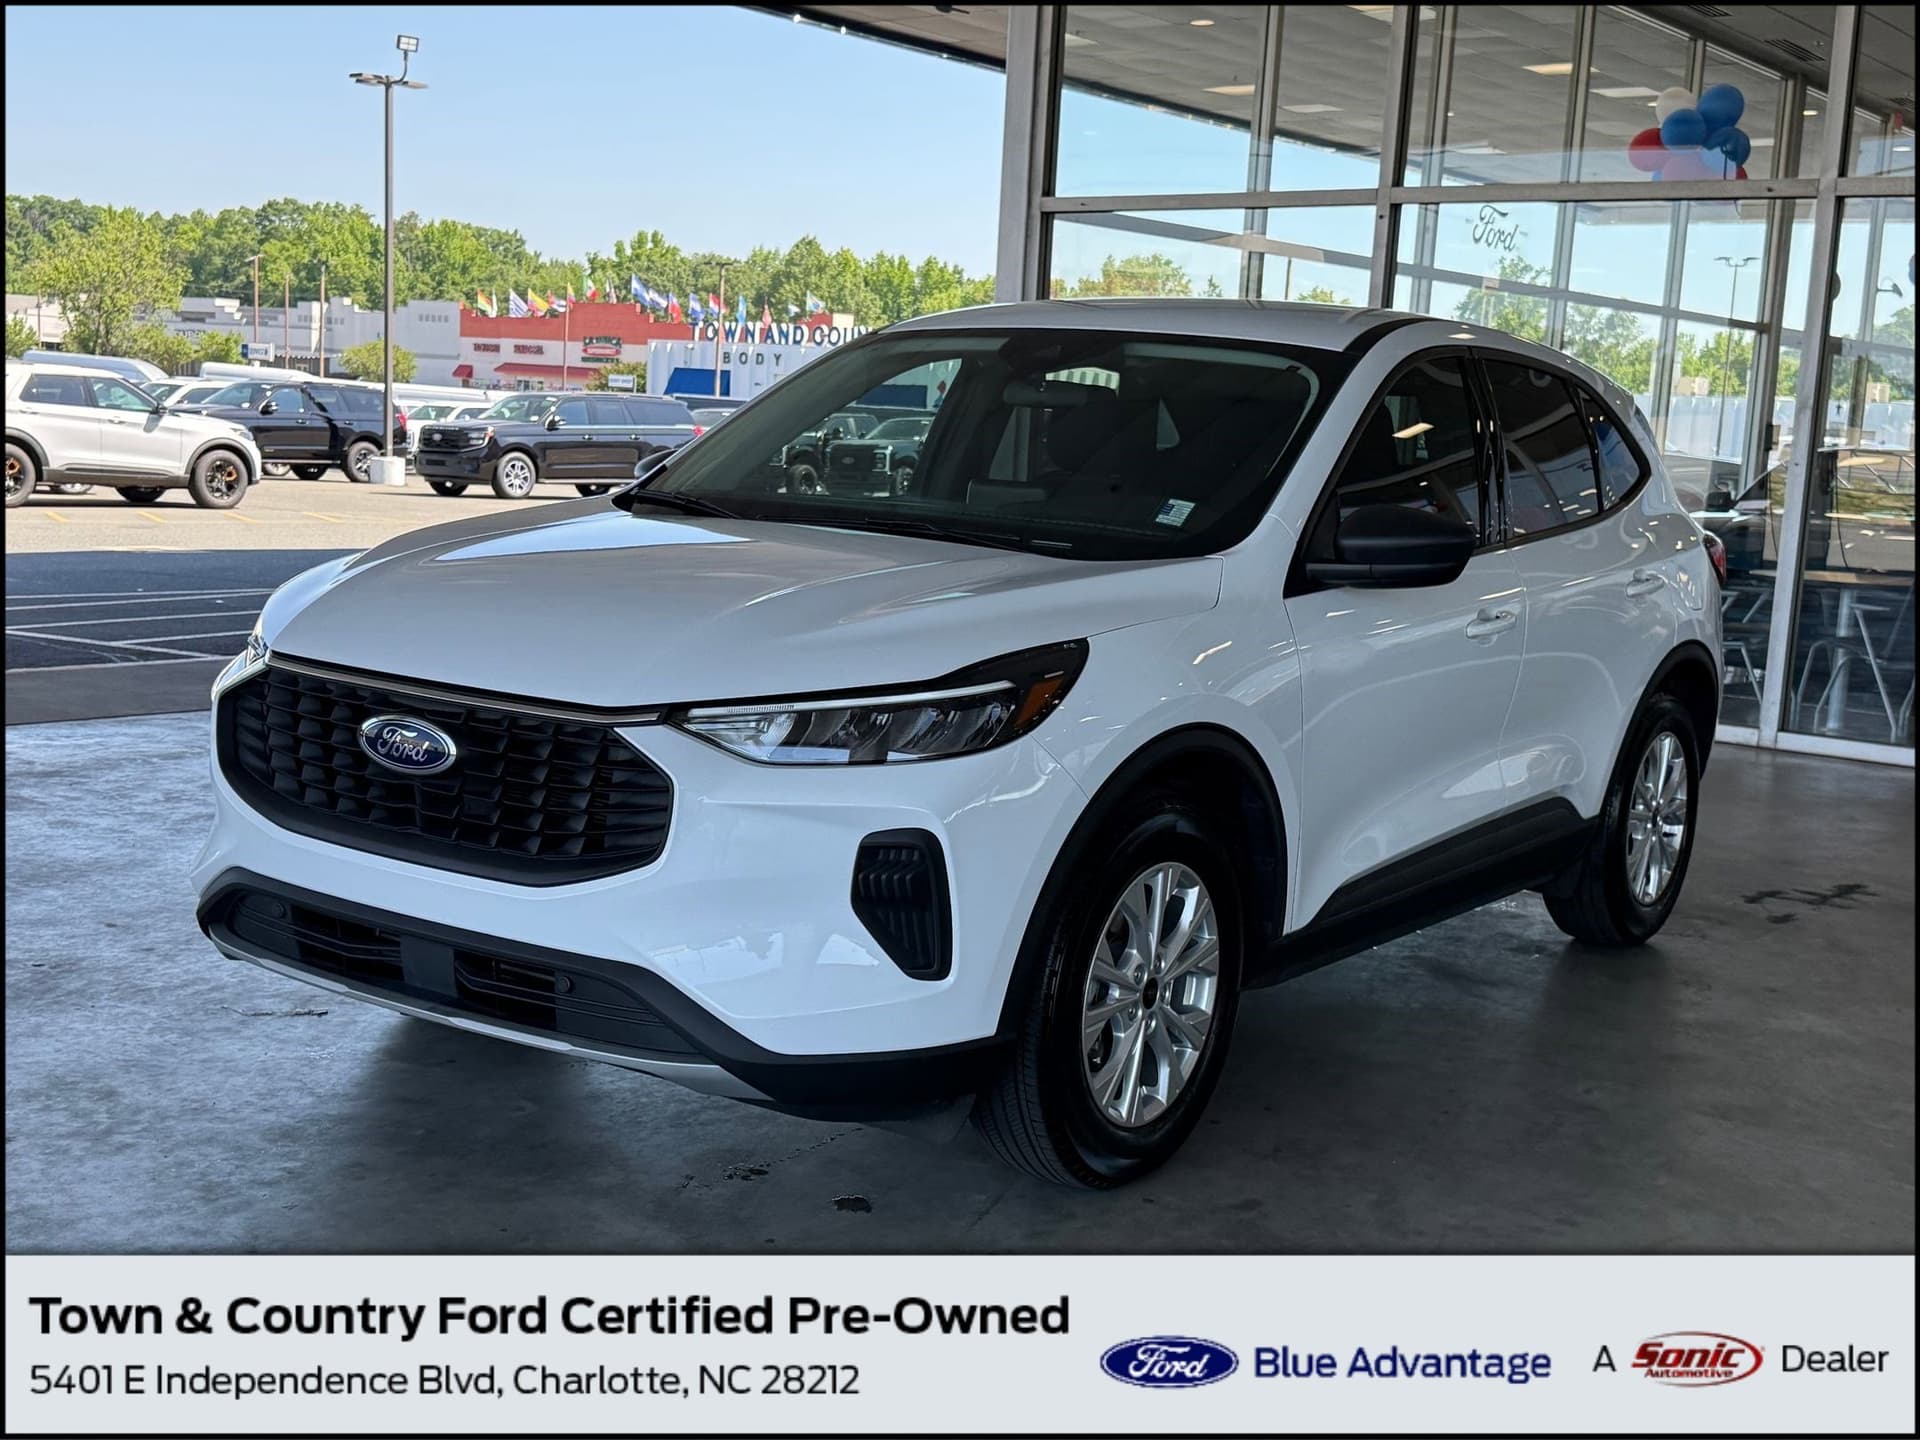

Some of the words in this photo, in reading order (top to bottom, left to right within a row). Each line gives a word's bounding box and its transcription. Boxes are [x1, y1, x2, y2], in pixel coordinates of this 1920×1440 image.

[1472, 204, 1519, 252] Ford
[689, 321, 758, 344] TOWN
[765, 323, 806, 346] AND
[722, 351, 783, 366] BODY
[376, 726, 429, 762] Ford
